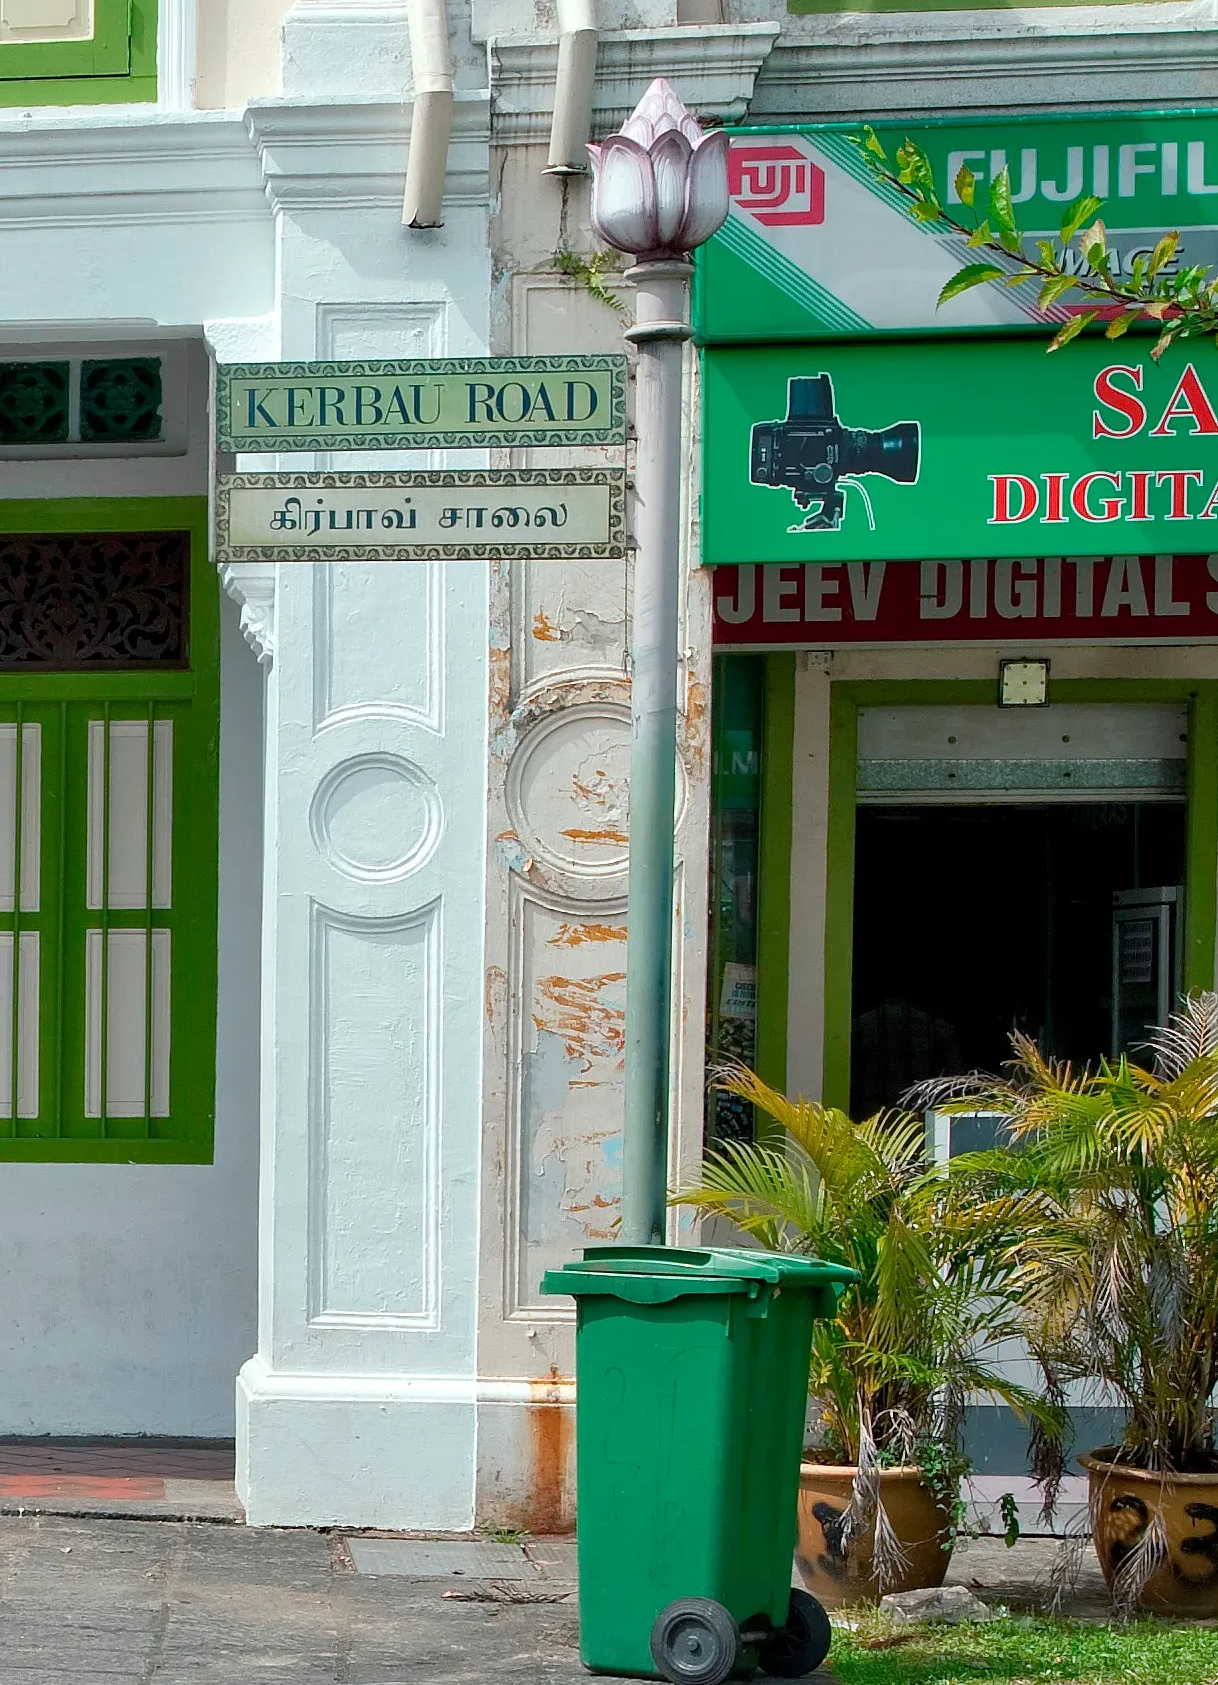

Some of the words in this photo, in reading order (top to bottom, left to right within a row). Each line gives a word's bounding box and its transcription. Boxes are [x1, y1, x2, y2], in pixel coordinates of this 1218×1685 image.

[729, 146, 811, 211] FUJI
[1048, 245, 1185, 277] MAGE
[243, 384, 446, 430] KERBAU
[465, 381, 598, 425] ROAD
[438, 502, 569, 529] சாலை
[712, 562, 887, 623] JEEV
[919, 555, 1190, 620] DIGITAL
